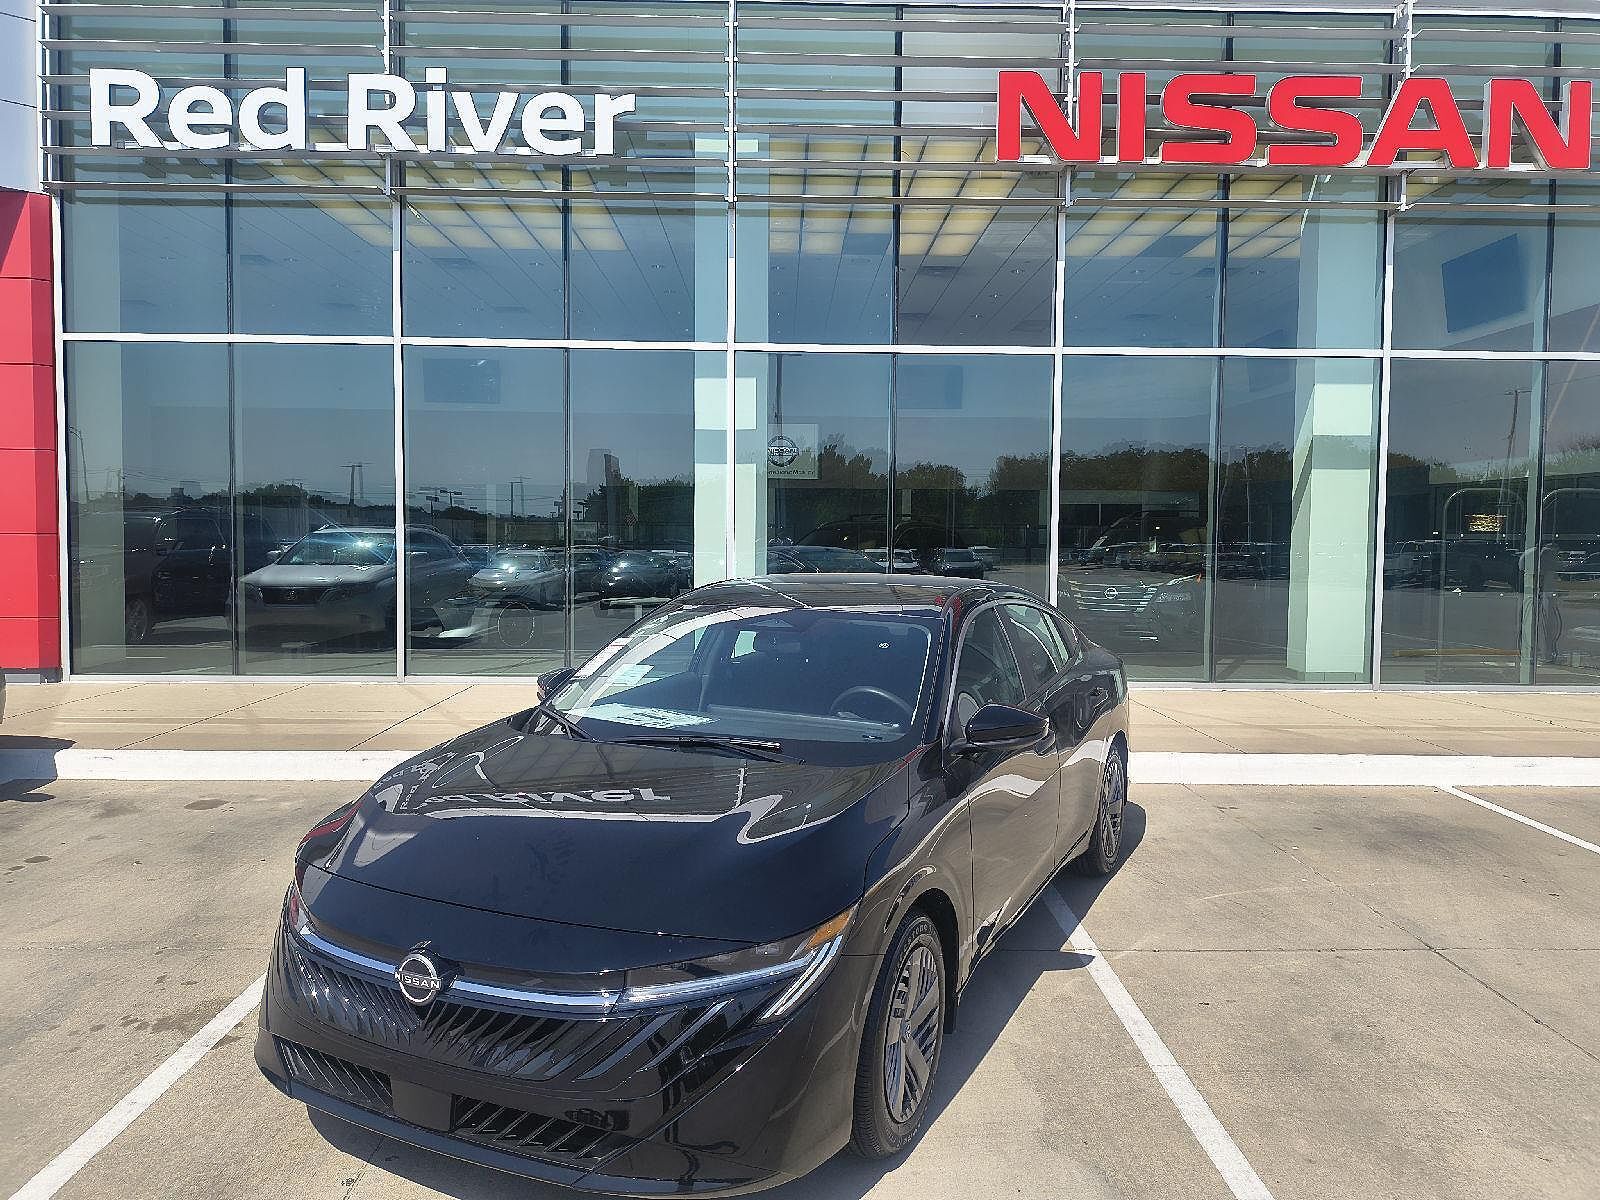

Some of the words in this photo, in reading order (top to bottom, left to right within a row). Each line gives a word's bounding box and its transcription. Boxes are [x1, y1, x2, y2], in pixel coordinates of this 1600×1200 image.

[89, 67, 306, 150] Red
[347, 67, 636, 156] River
[996, 71, 1592, 169] NISSAN
[395, 972, 440, 989] NISSAN
